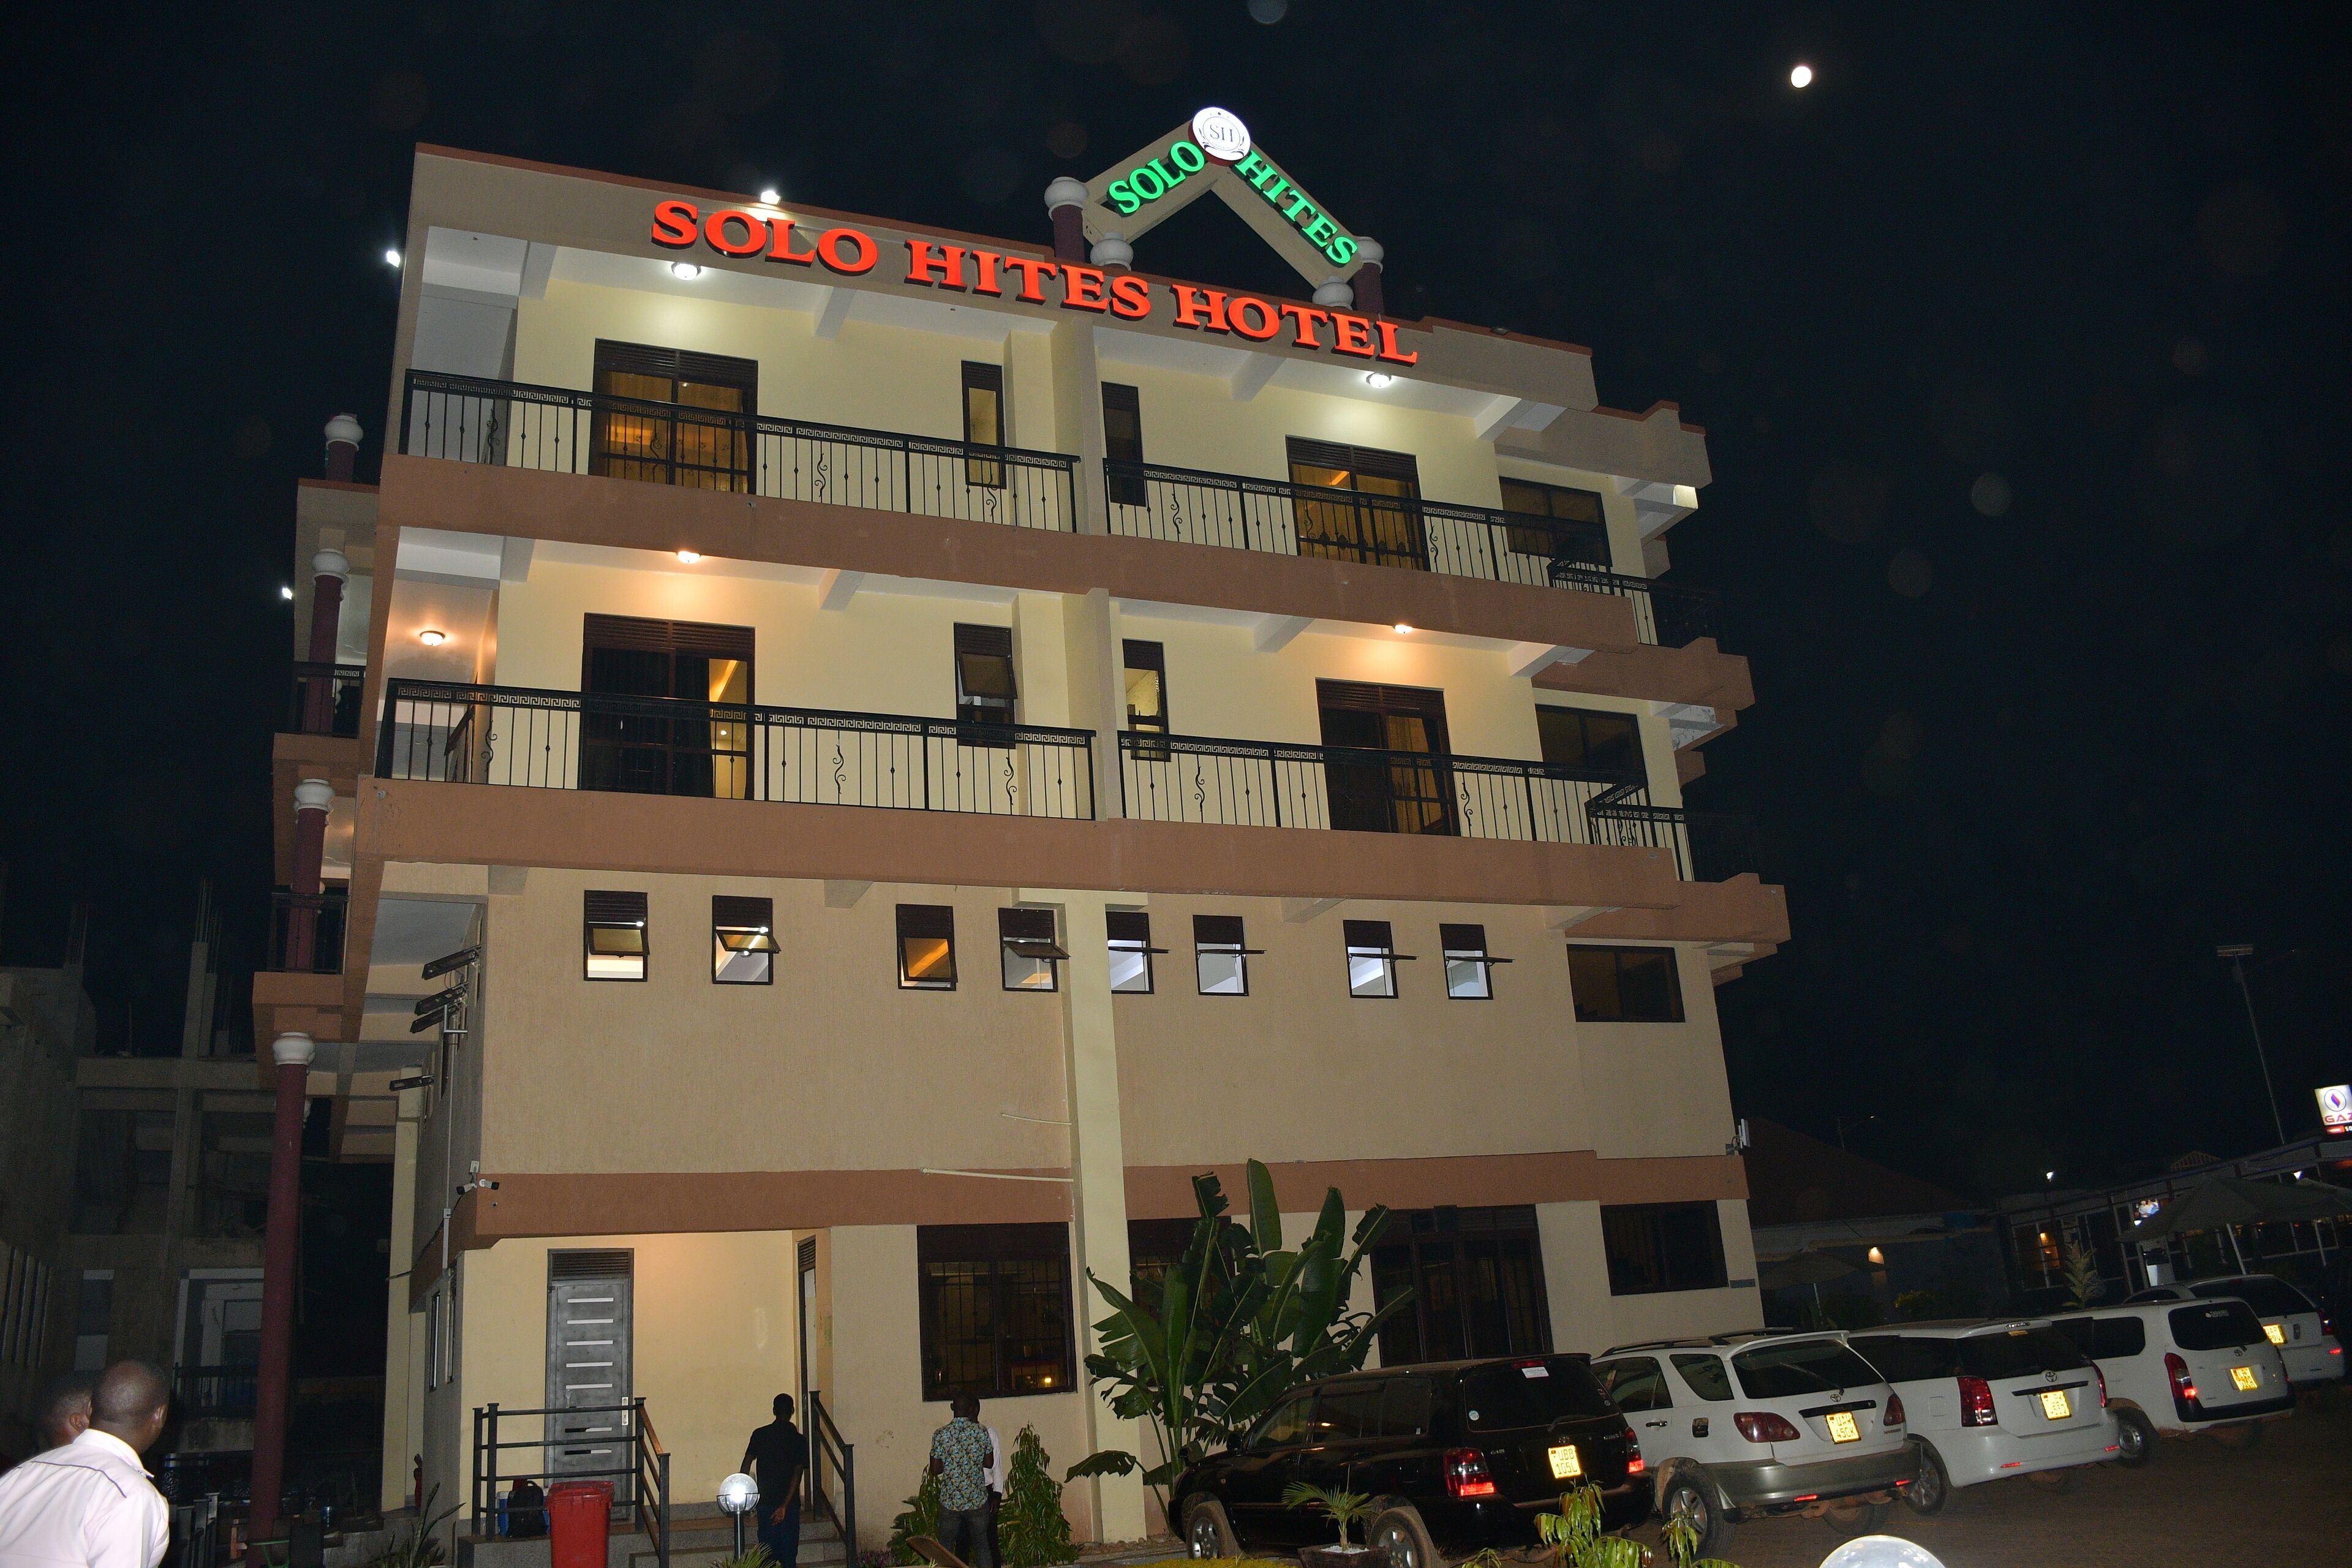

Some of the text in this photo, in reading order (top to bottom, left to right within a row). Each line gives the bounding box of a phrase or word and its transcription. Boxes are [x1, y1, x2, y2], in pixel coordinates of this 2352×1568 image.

[1109, 141, 1358, 265] SOLO HITES
[652, 200, 1418, 364] SOLO HITES HOTEL
[1556, 1461, 1578, 1475] 105L
[1558, 1448, 1574, 1461] UBB
